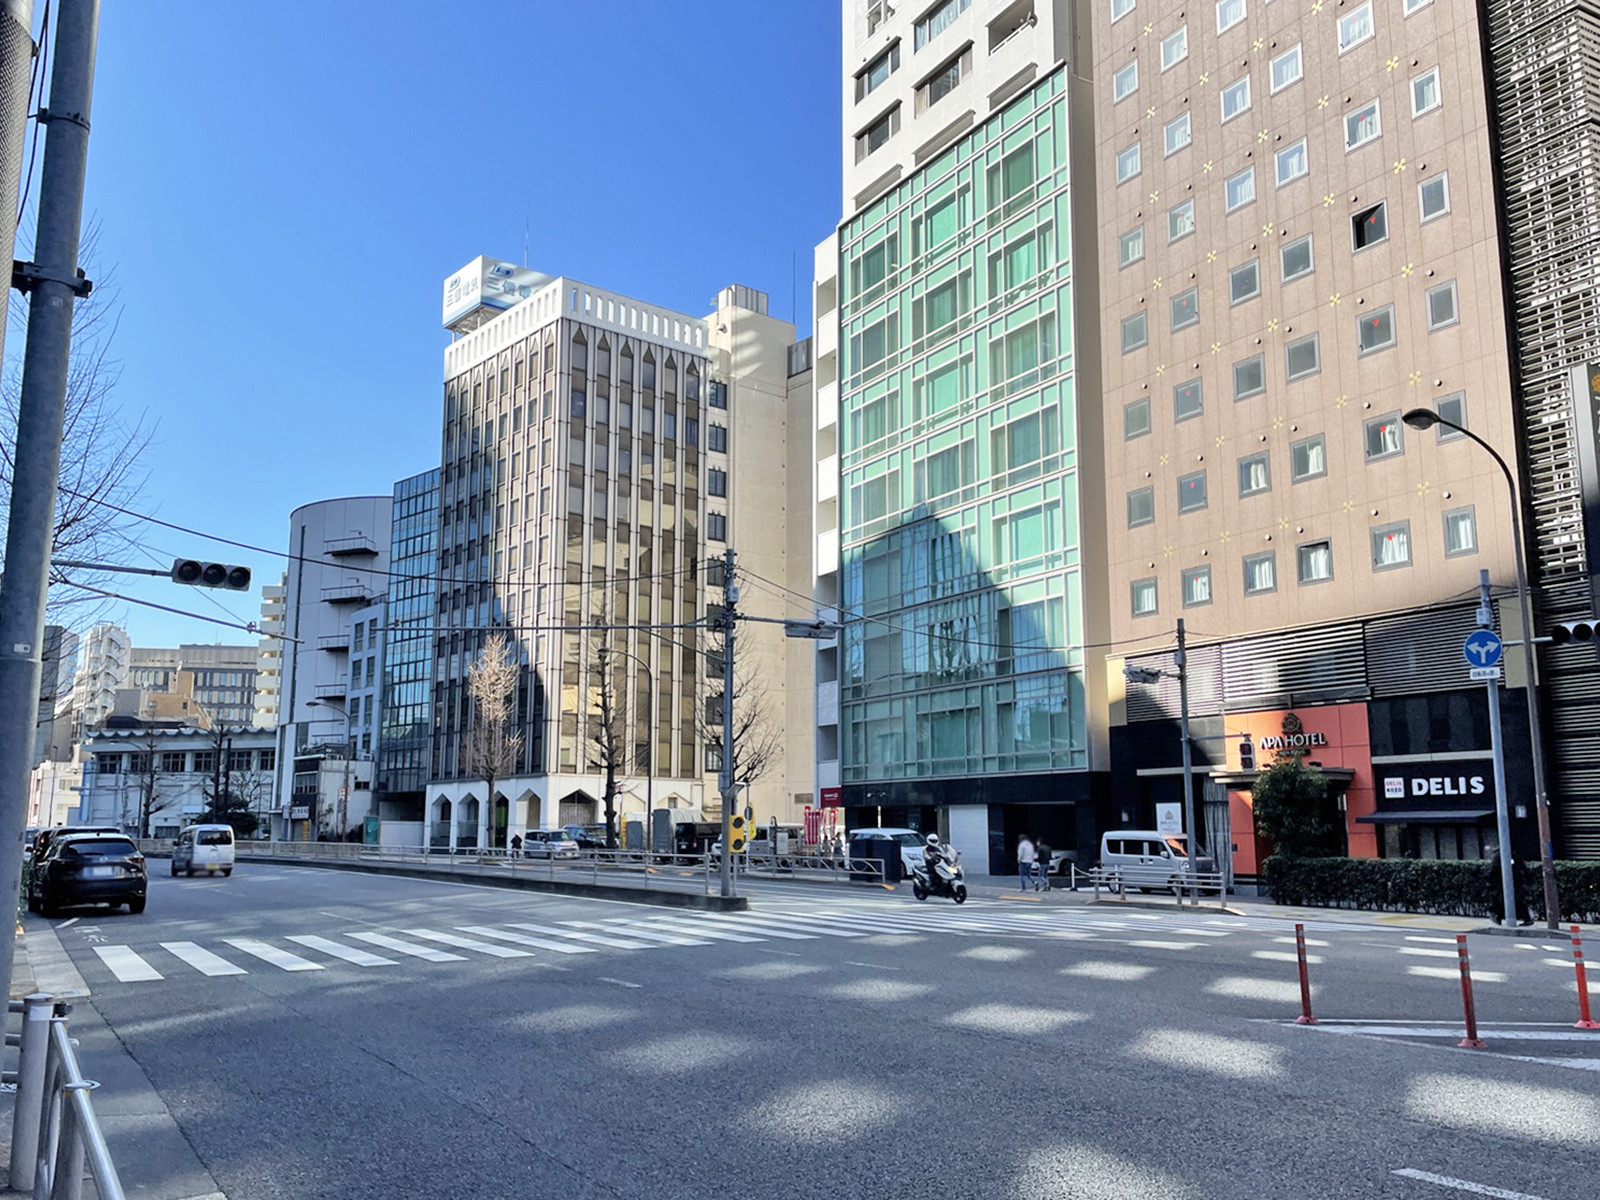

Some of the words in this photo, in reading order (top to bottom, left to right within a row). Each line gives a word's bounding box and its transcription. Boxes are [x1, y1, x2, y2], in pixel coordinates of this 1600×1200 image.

[1260, 735, 1283, 749] APA
[1284, 732, 1327, 747] HOTEL
[1411, 776, 1485, 796] DELIS
